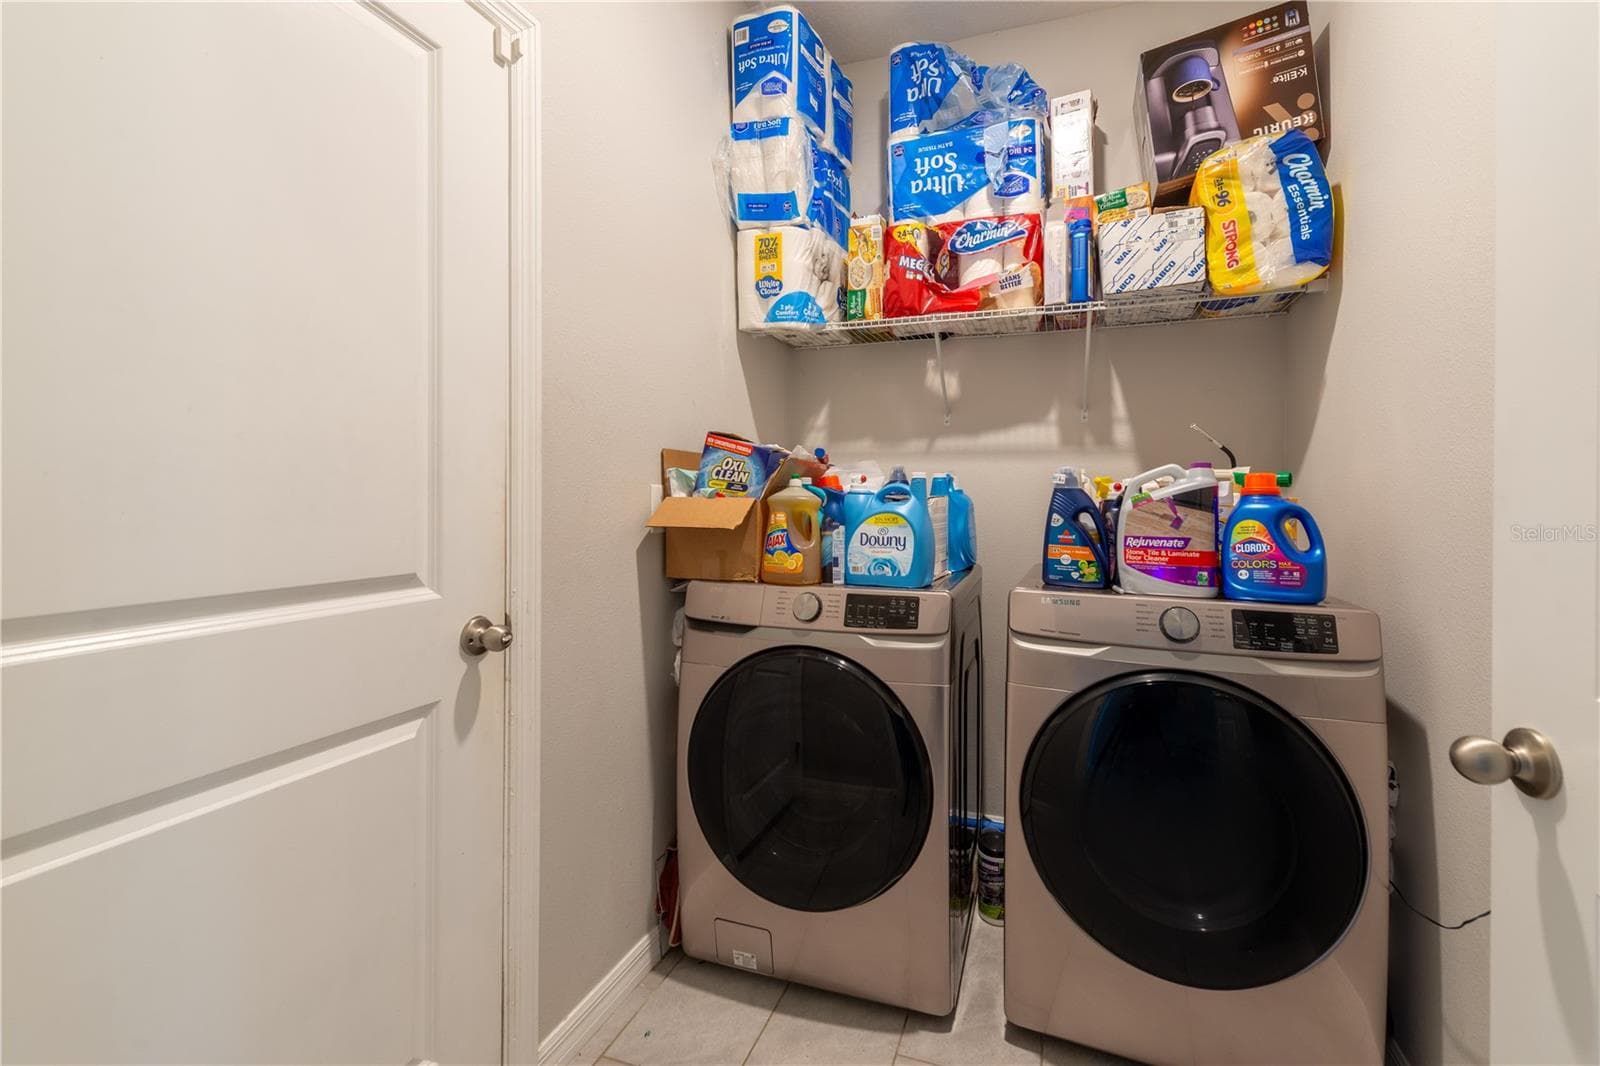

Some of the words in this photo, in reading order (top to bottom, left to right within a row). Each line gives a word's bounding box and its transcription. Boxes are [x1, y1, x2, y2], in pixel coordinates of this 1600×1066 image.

[738, 56, 758, 74] Soft
[759, 52, 785, 66] Ultra
[1253, 111, 1314, 136] KEURIG
[913, 152, 958, 177] Soft
[910, 172, 963, 196] Ultra
[1282, 153, 1329, 212] Charmin
[1287, 183, 1313, 241] Essentials
[758, 236, 779, 249] 70%
[955, 224, 1014, 249] Charmin
[1222, 219, 1240, 269] STRONG
[758, 246, 778, 256] MORE
[758, 279, 781, 291] White
[760, 286, 782, 296] Cloud
[721, 457, 744, 470] OXI
[711, 466, 749, 483] CLEAN
[767, 532, 786, 548] AJAX
[860, 532, 907, 551] Downy
[1126, 537, 1185, 549] Rejuvenate
[1231, 560, 1277, 569] COLORS
